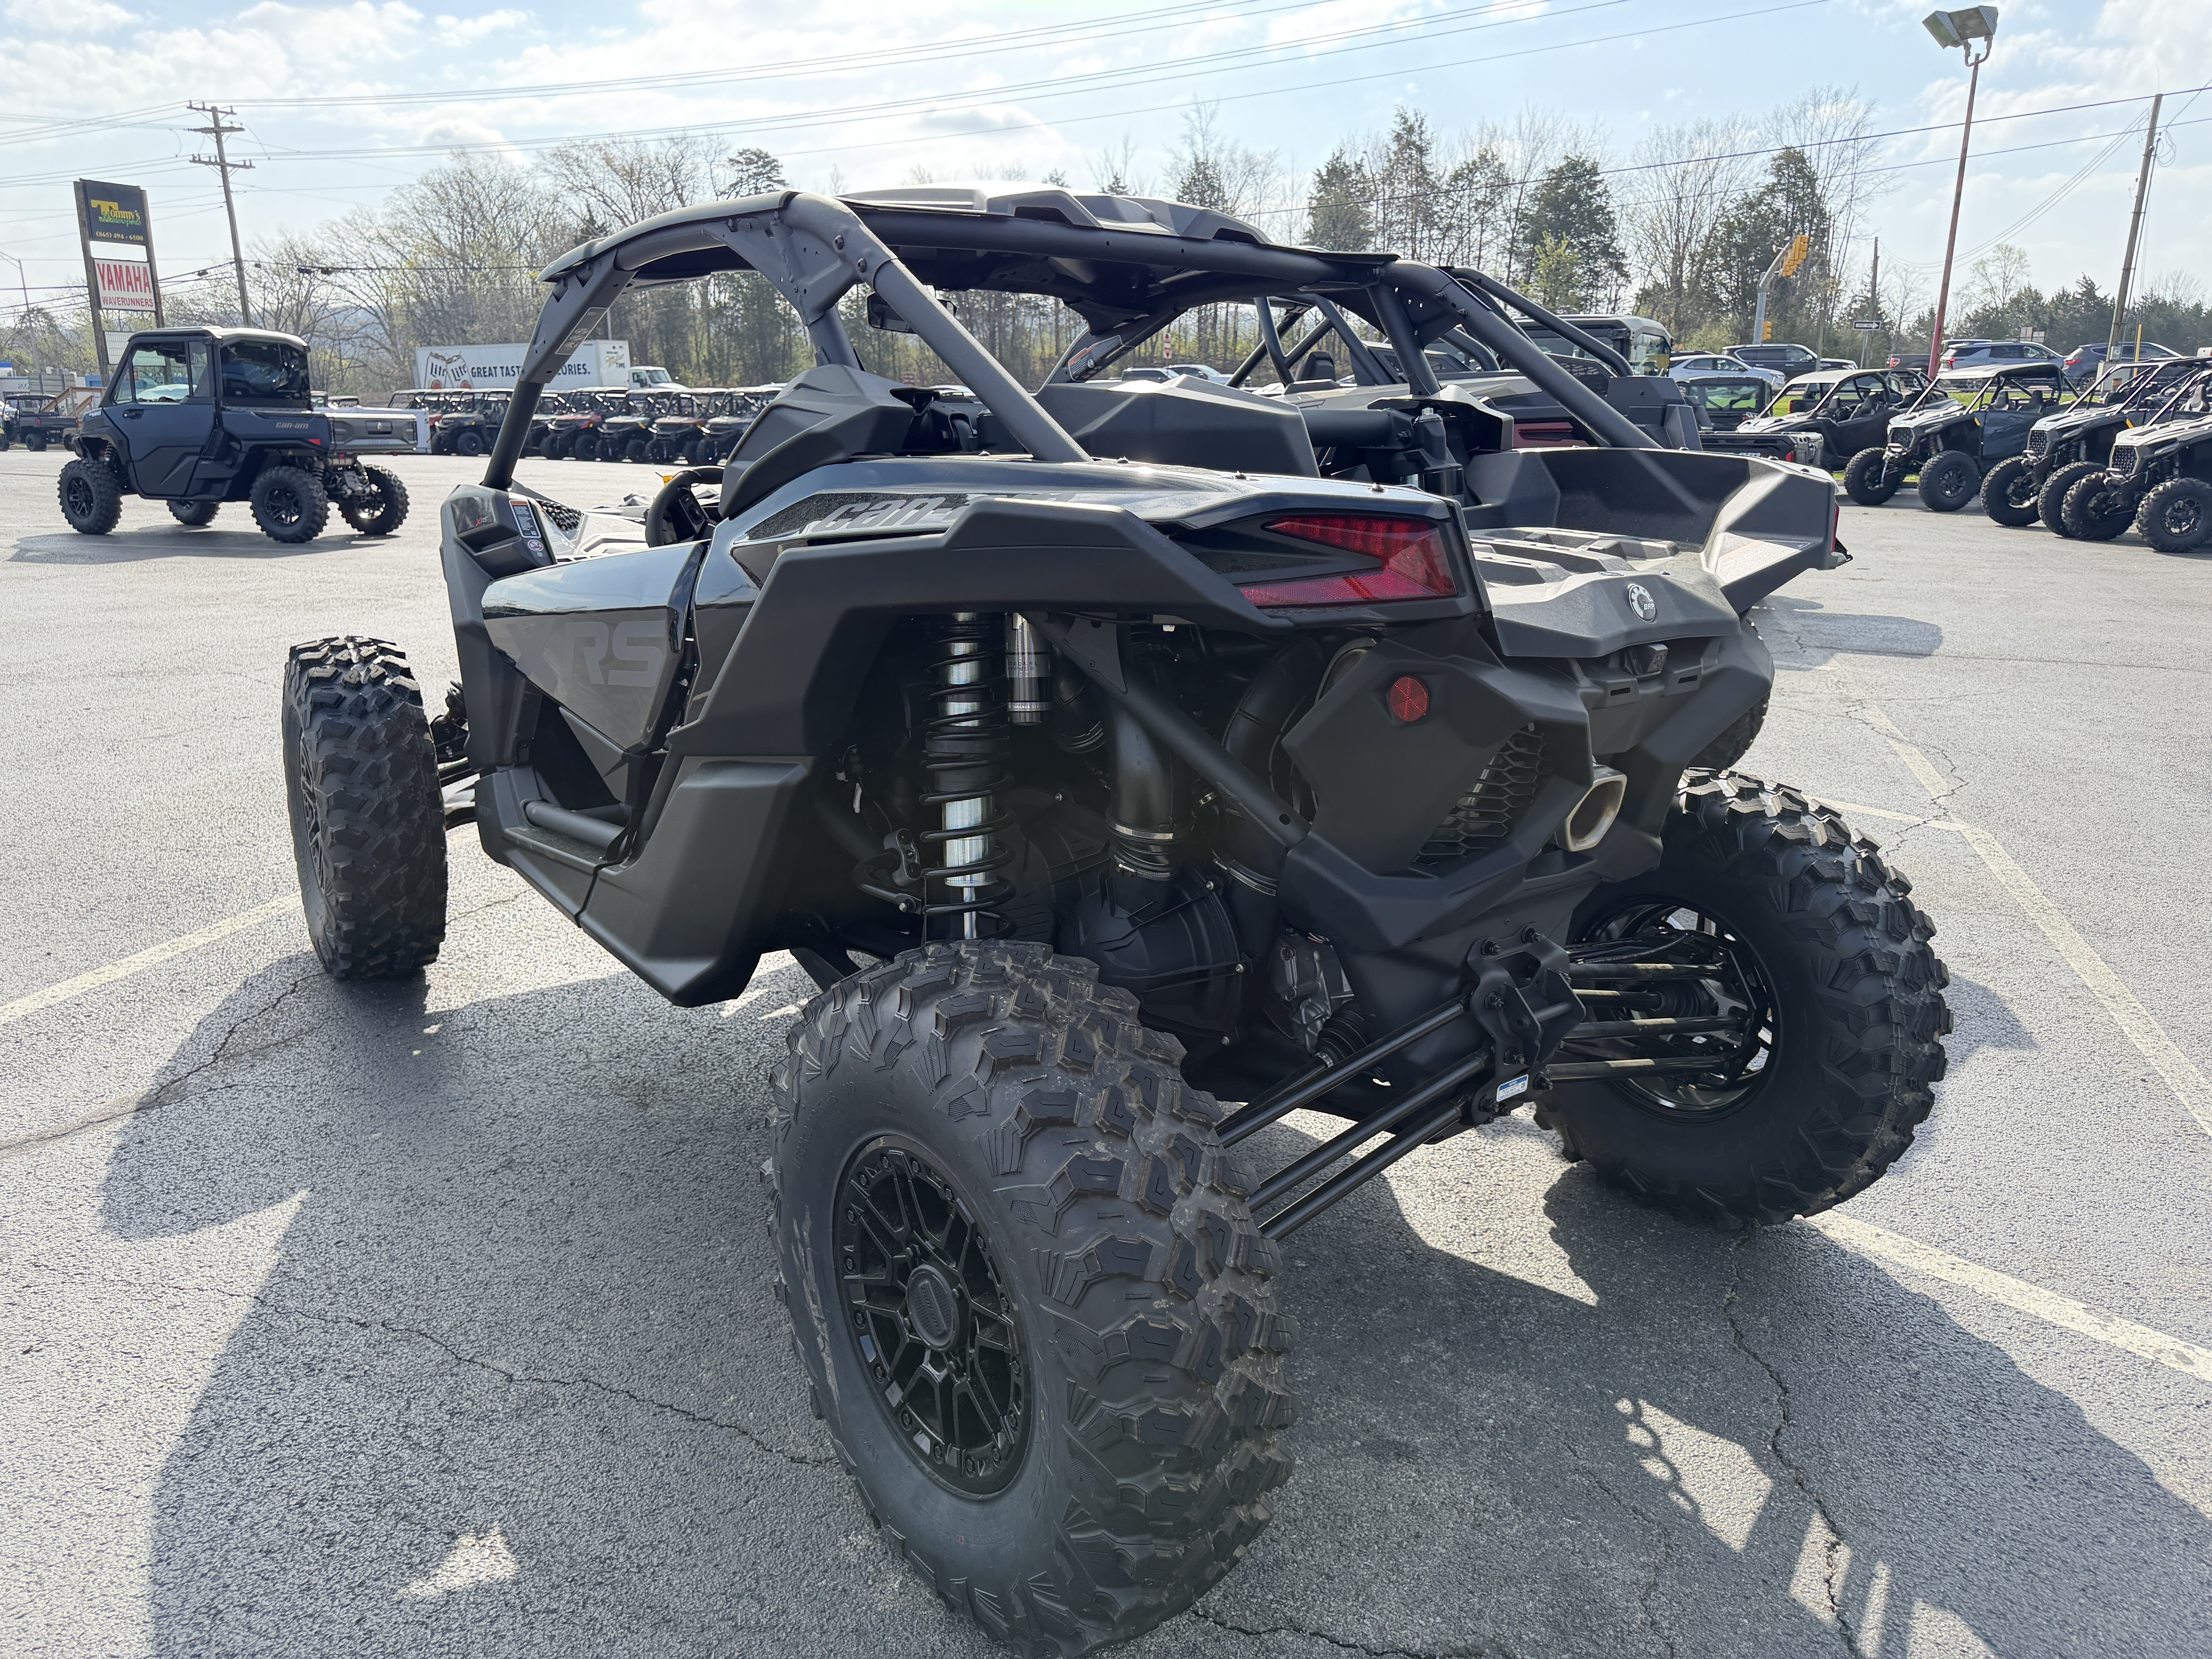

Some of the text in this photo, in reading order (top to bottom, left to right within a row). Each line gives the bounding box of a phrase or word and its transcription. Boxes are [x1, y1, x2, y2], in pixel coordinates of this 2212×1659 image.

[91, 199, 140, 223] Tommy's
[97, 263, 151, 293] YAMAHA
[102, 296, 153, 307] WAVERUNNERS
[471, 363, 591, 378] GREAT TAST ORIES.
